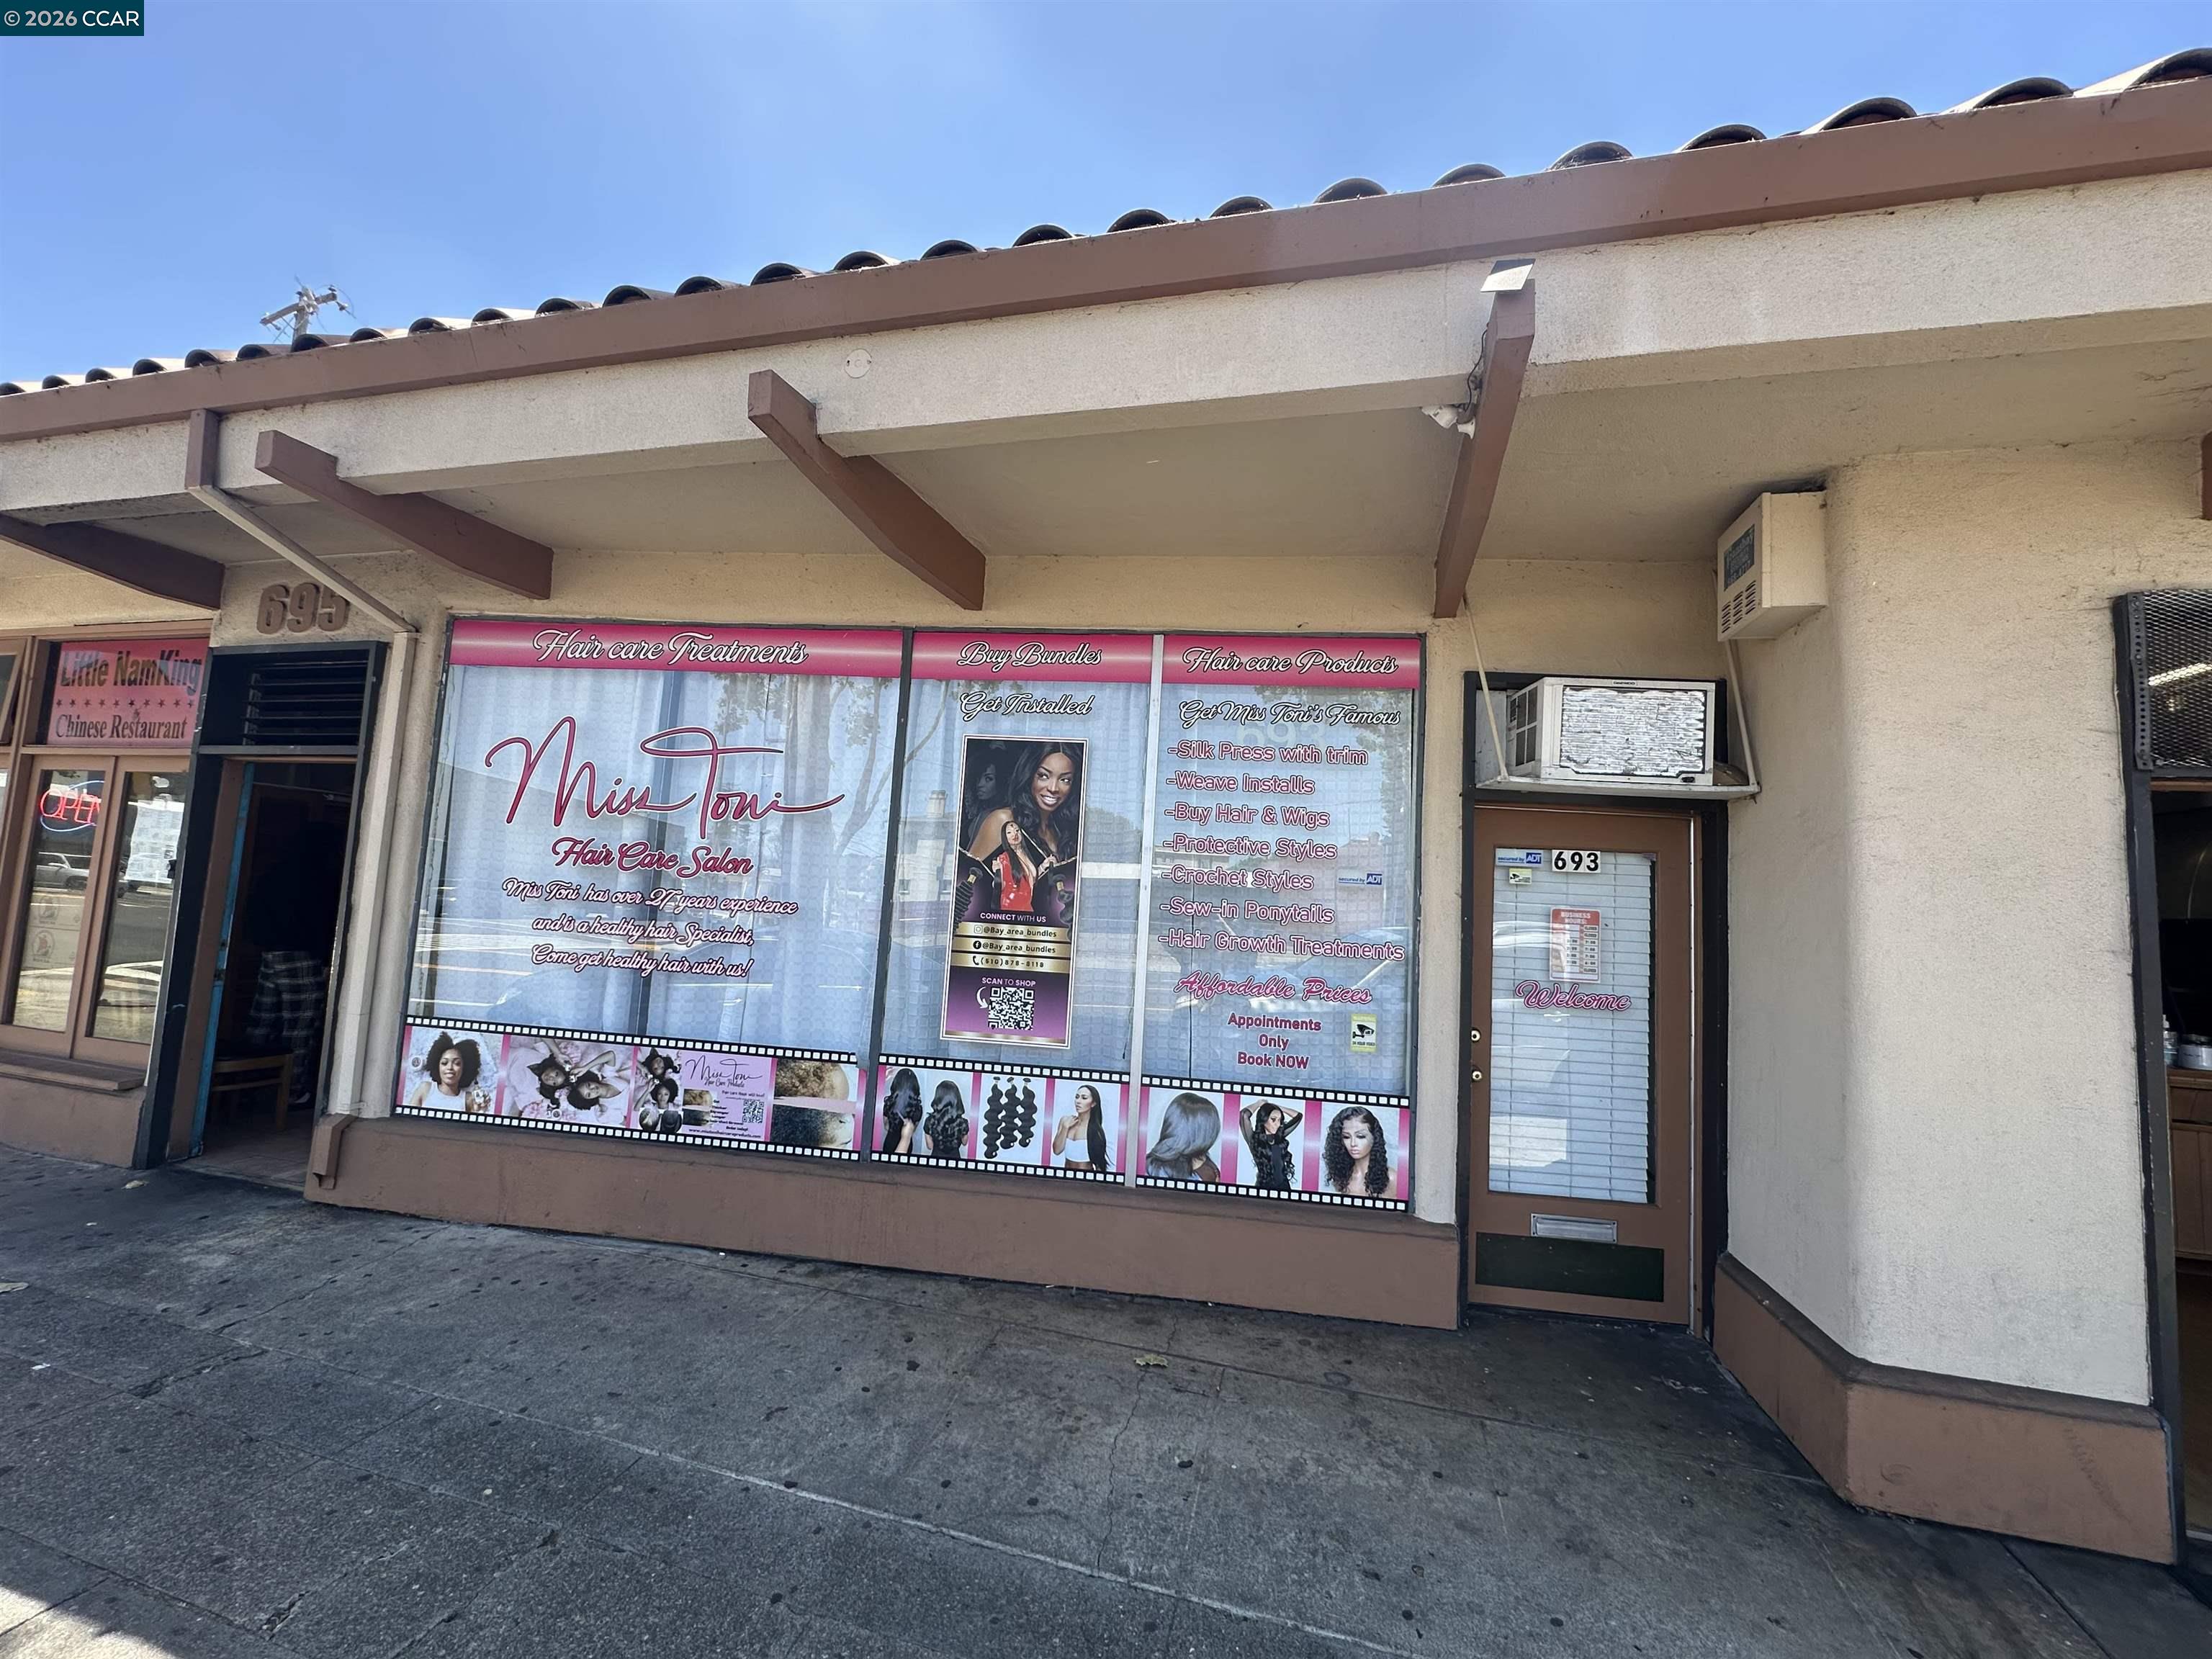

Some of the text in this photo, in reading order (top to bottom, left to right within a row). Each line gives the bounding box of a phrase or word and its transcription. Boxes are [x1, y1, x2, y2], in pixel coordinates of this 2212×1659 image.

[256, 582, 351, 634] 695
[532, 629, 809, 665] Hair care Treatments
[957, 641, 1102, 673] Buy Bundles
[1182, 647, 1400, 675] Hair care Products
[60, 651, 109, 686] Little
[960, 691, 1095, 721] Get Installed
[1179, 700, 1401, 729] Get Miss Toni's Famous
[55, 714, 188, 739] Chinese Restaurant
[1167, 739, 1369, 765] -Silk Press with trim
[484, 715, 846, 840] Miss Toni
[1166, 771, 1316, 794] -Weave Installs
[1164, 802, 1331, 830] -Buy Hair & Wigs
[552, 837, 754, 878] Hair Care Salon
[1163, 833, 1338, 863] -Protective Styles
[1554, 851, 1599, 872] 693
[1161, 864, 1314, 894] -Crochet Styles
[1367, 875, 1382, 884] ADT
[503, 878, 799, 918] Miss Toni has over 27 years experience
[1244, 900, 1335, 925] Ponytails
[532, 913, 755, 947] and is a healthy hair Specialist,
[1158, 929, 1406, 961] -Hair Growth Treatments
[531, 943, 754, 978] Come get healthy hair with us!
[982, 942, 1056, 953] @Bay_area_bundles
[1174, 970, 1372, 1004] Affordable Prices
[1516, 980, 1632, 1011] Welcome
[1227, 1012, 1322, 1032] Appointments
[1259, 1033, 1290, 1051] Only
[1237, 1051, 1310, 1069] Book NOW
